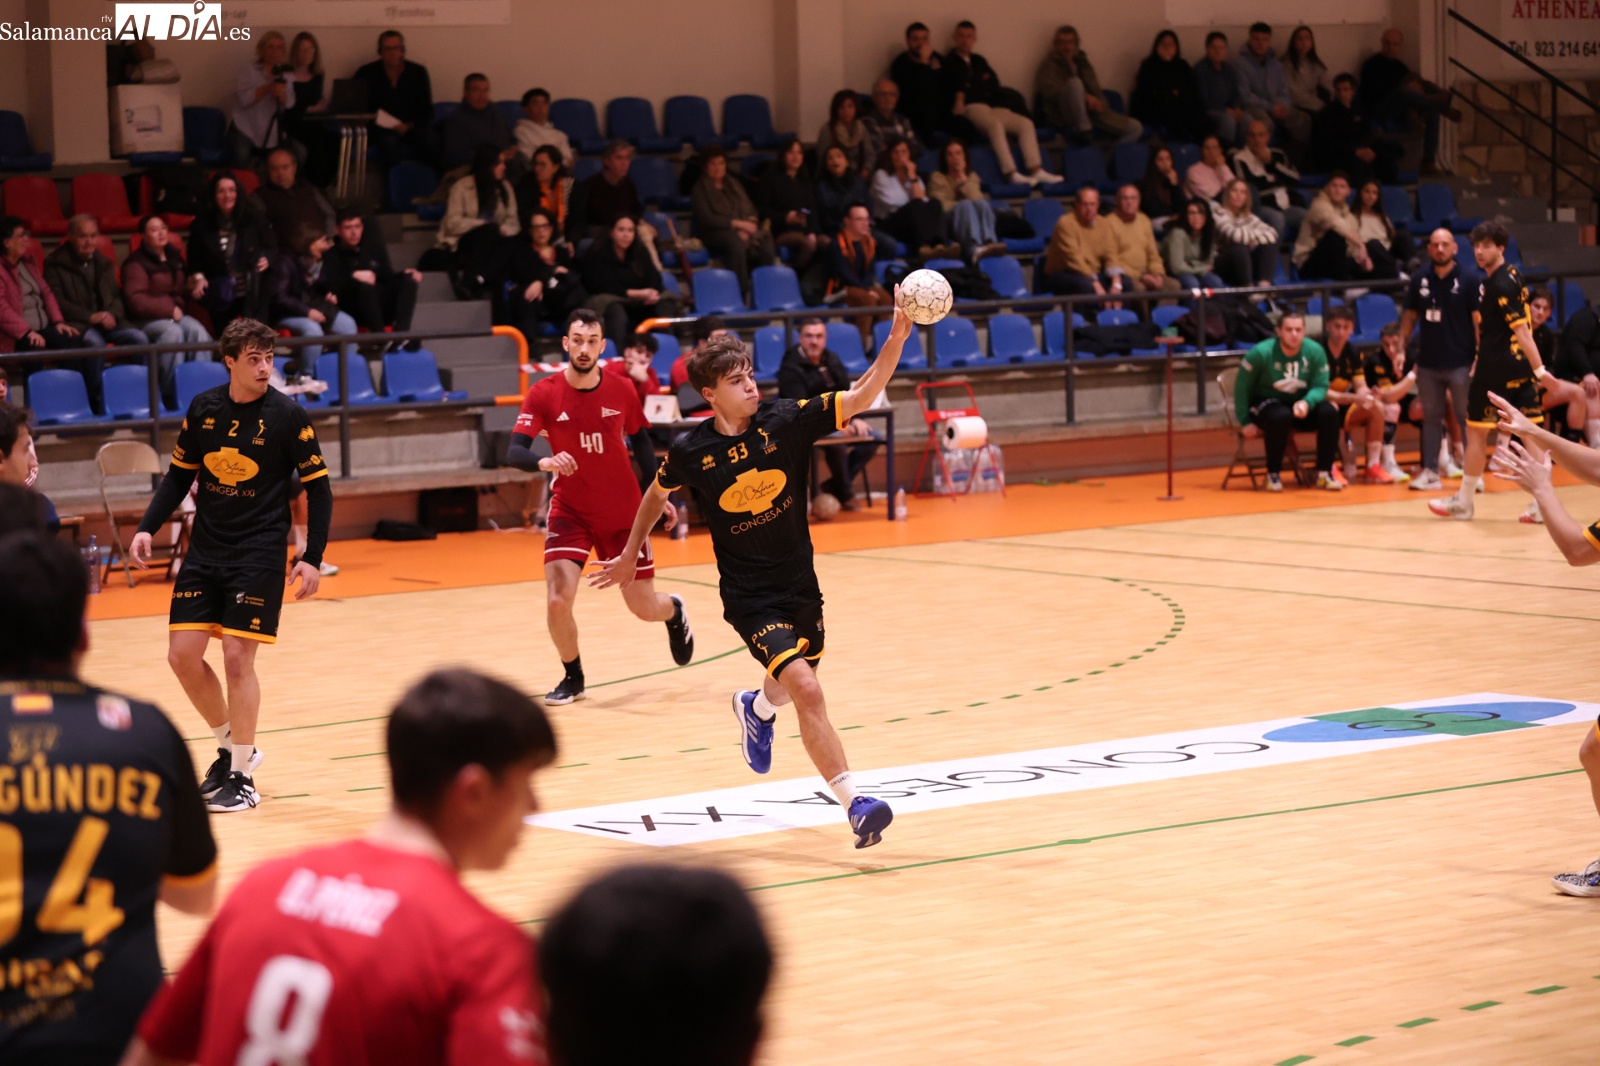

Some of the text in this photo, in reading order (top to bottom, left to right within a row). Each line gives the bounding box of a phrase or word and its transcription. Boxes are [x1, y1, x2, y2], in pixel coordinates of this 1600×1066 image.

[1534, 41, 1555, 57] 923
[1559, 41, 1579, 57] 214
[228, 419, 240, 437] 2
[579, 431, 604, 454] 40
[727, 441, 749, 464] 93
[241, 488, 256, 497] XXI
[731, 485, 755, 508] 20
[730, 494, 793, 535] CONGESA XXI
[751, 622, 794, 644] Pubeer
[572, 741, 1270, 835] CONGESA XXI
[236, 954, 334, 1066] 8
